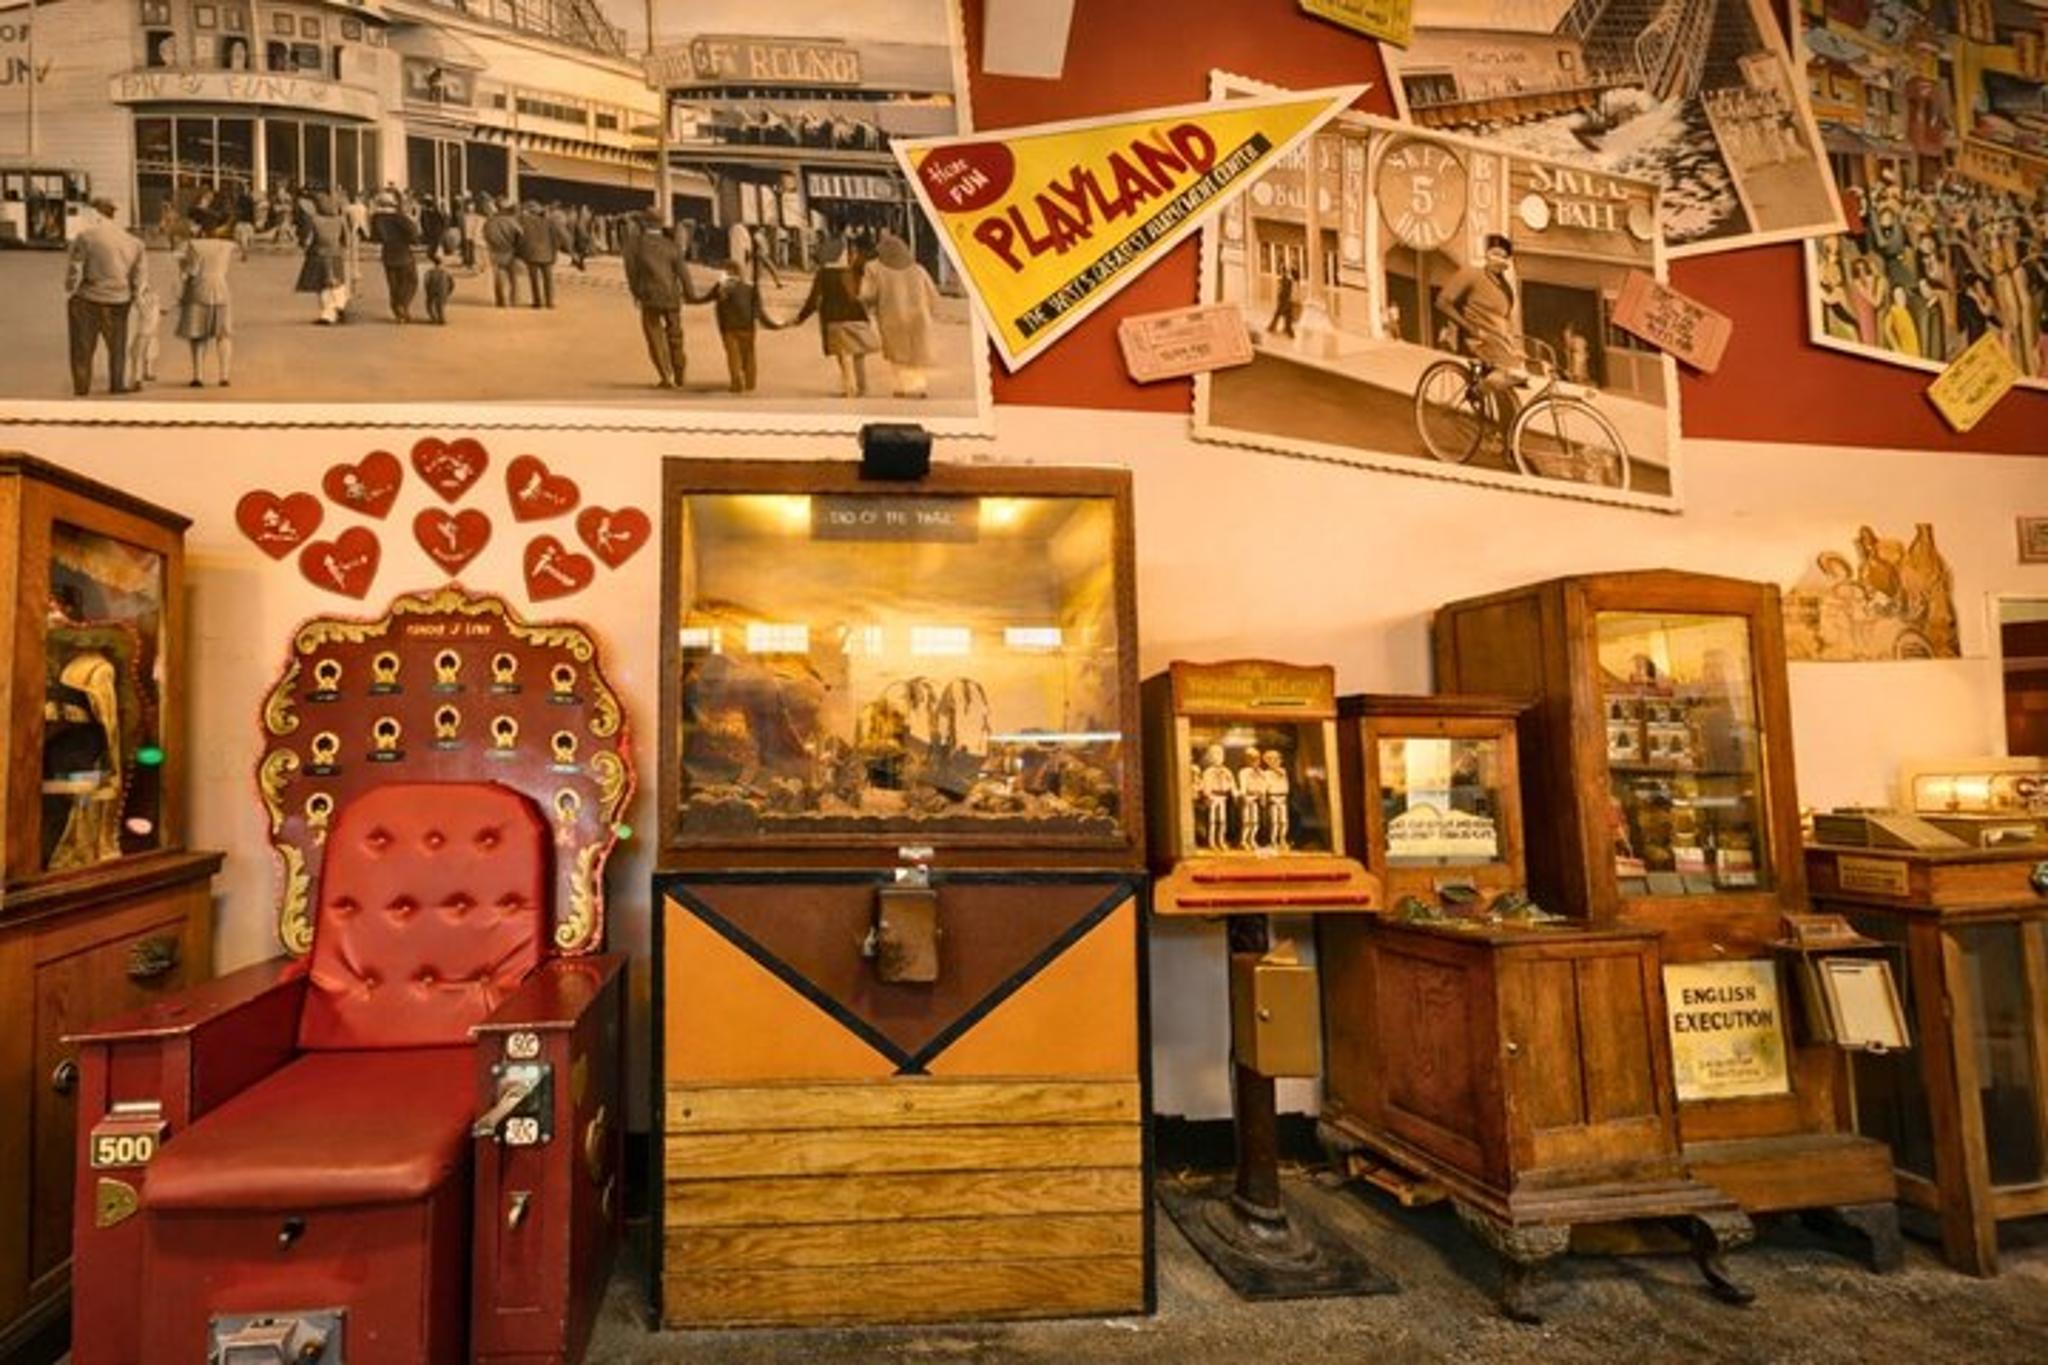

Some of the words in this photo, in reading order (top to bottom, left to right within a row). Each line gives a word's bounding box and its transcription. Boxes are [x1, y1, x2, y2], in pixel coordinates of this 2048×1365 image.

[1213, 143, 1260, 188] CENTER
[949, 167, 990, 206] FUN
[973, 122, 1217, 273] PLAYLAND
[1682, 985, 1757, 1006] ENGLISH
[1673, 1008, 1774, 1033] EXECUTION
[98, 1135, 153, 1165] 500
